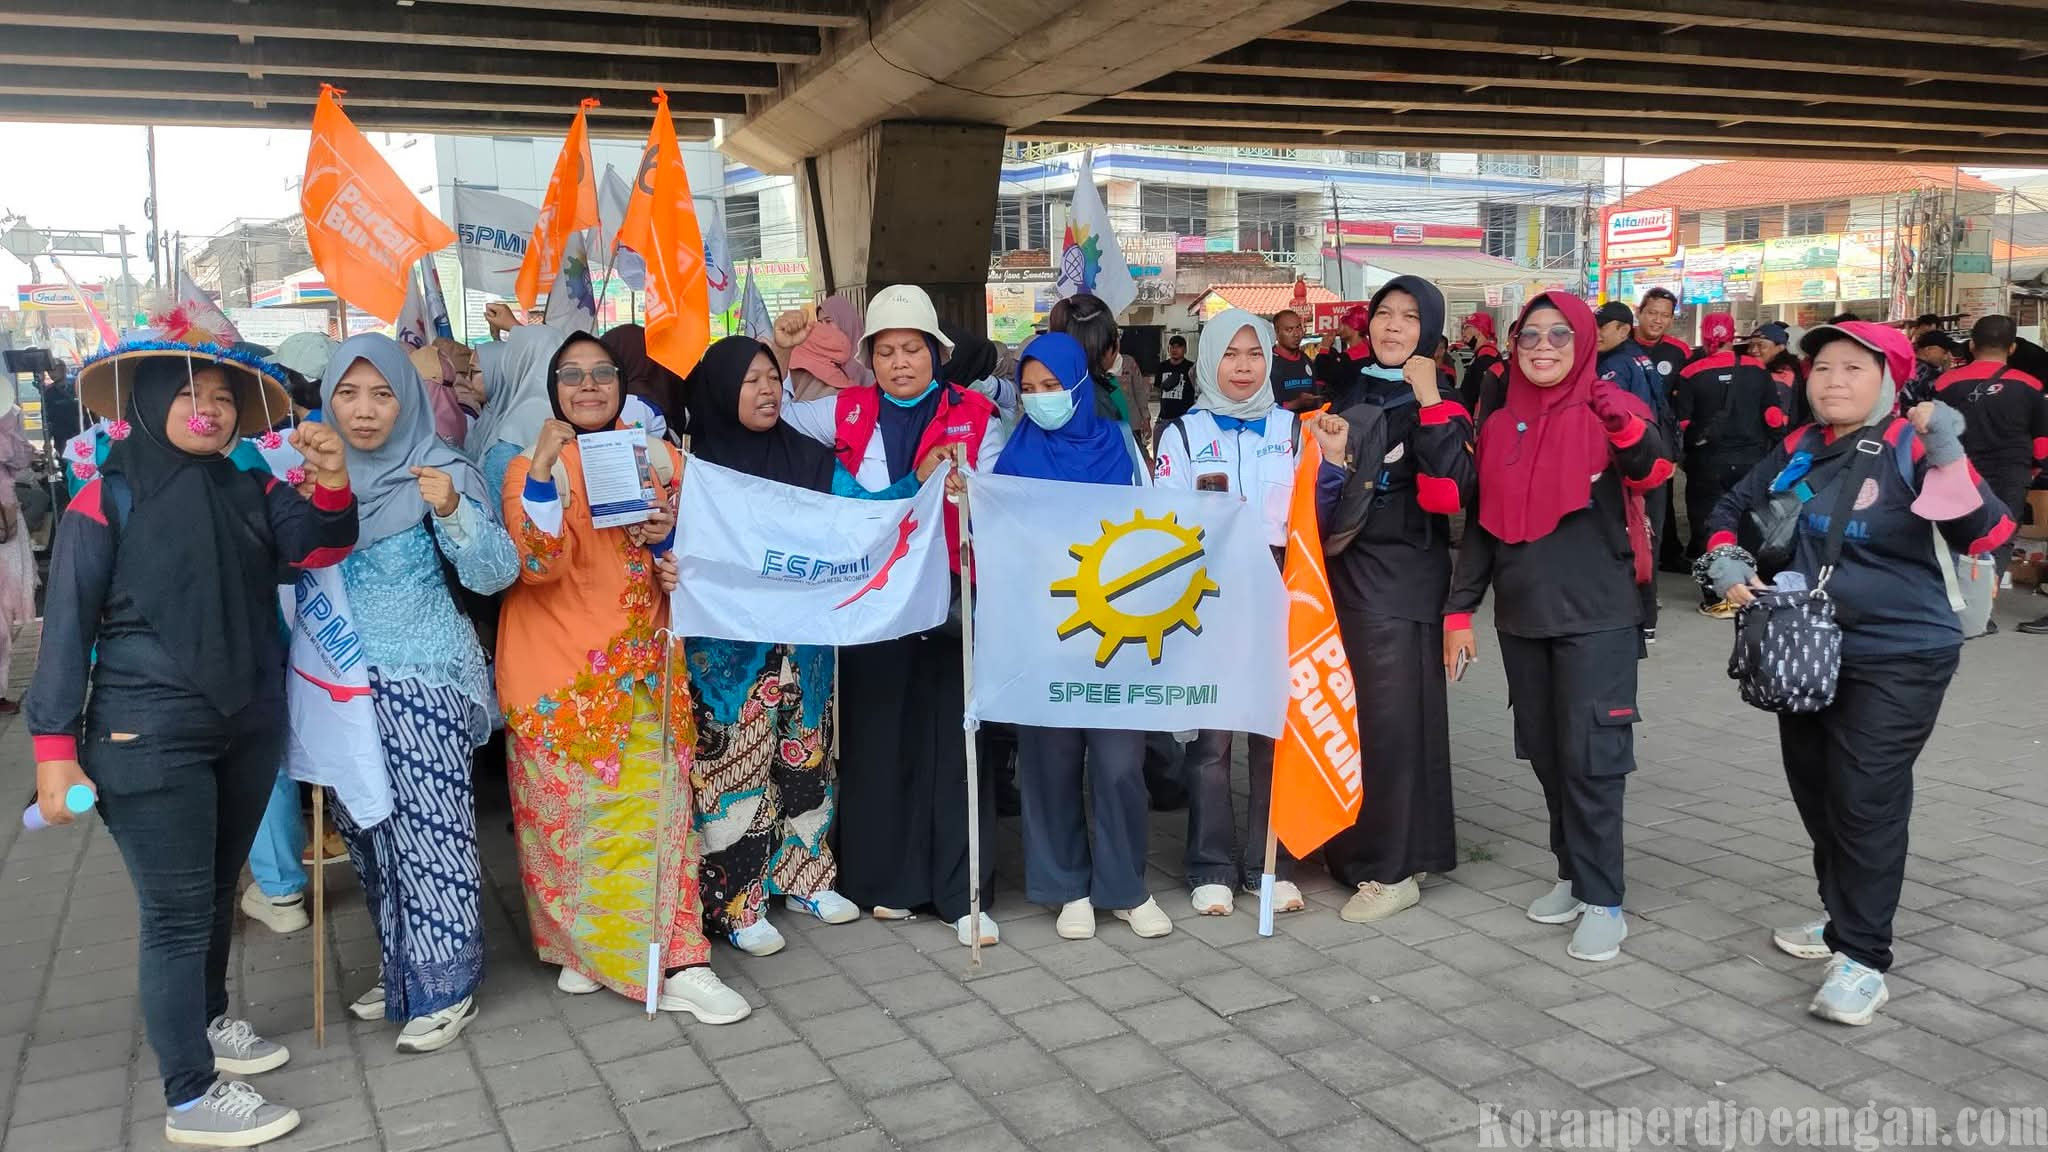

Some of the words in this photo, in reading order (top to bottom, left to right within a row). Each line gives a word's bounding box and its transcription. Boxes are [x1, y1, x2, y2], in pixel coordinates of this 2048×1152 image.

[336, 182, 417, 254] Partai
[1613, 213, 1667, 229] Alfamart
[1807, 512, 1870, 538] MEAL
[1049, 682, 1121, 704] SPEE
[1127, 684, 1218, 706] FSPMI
[1289, 656, 1361, 793] Buruh
